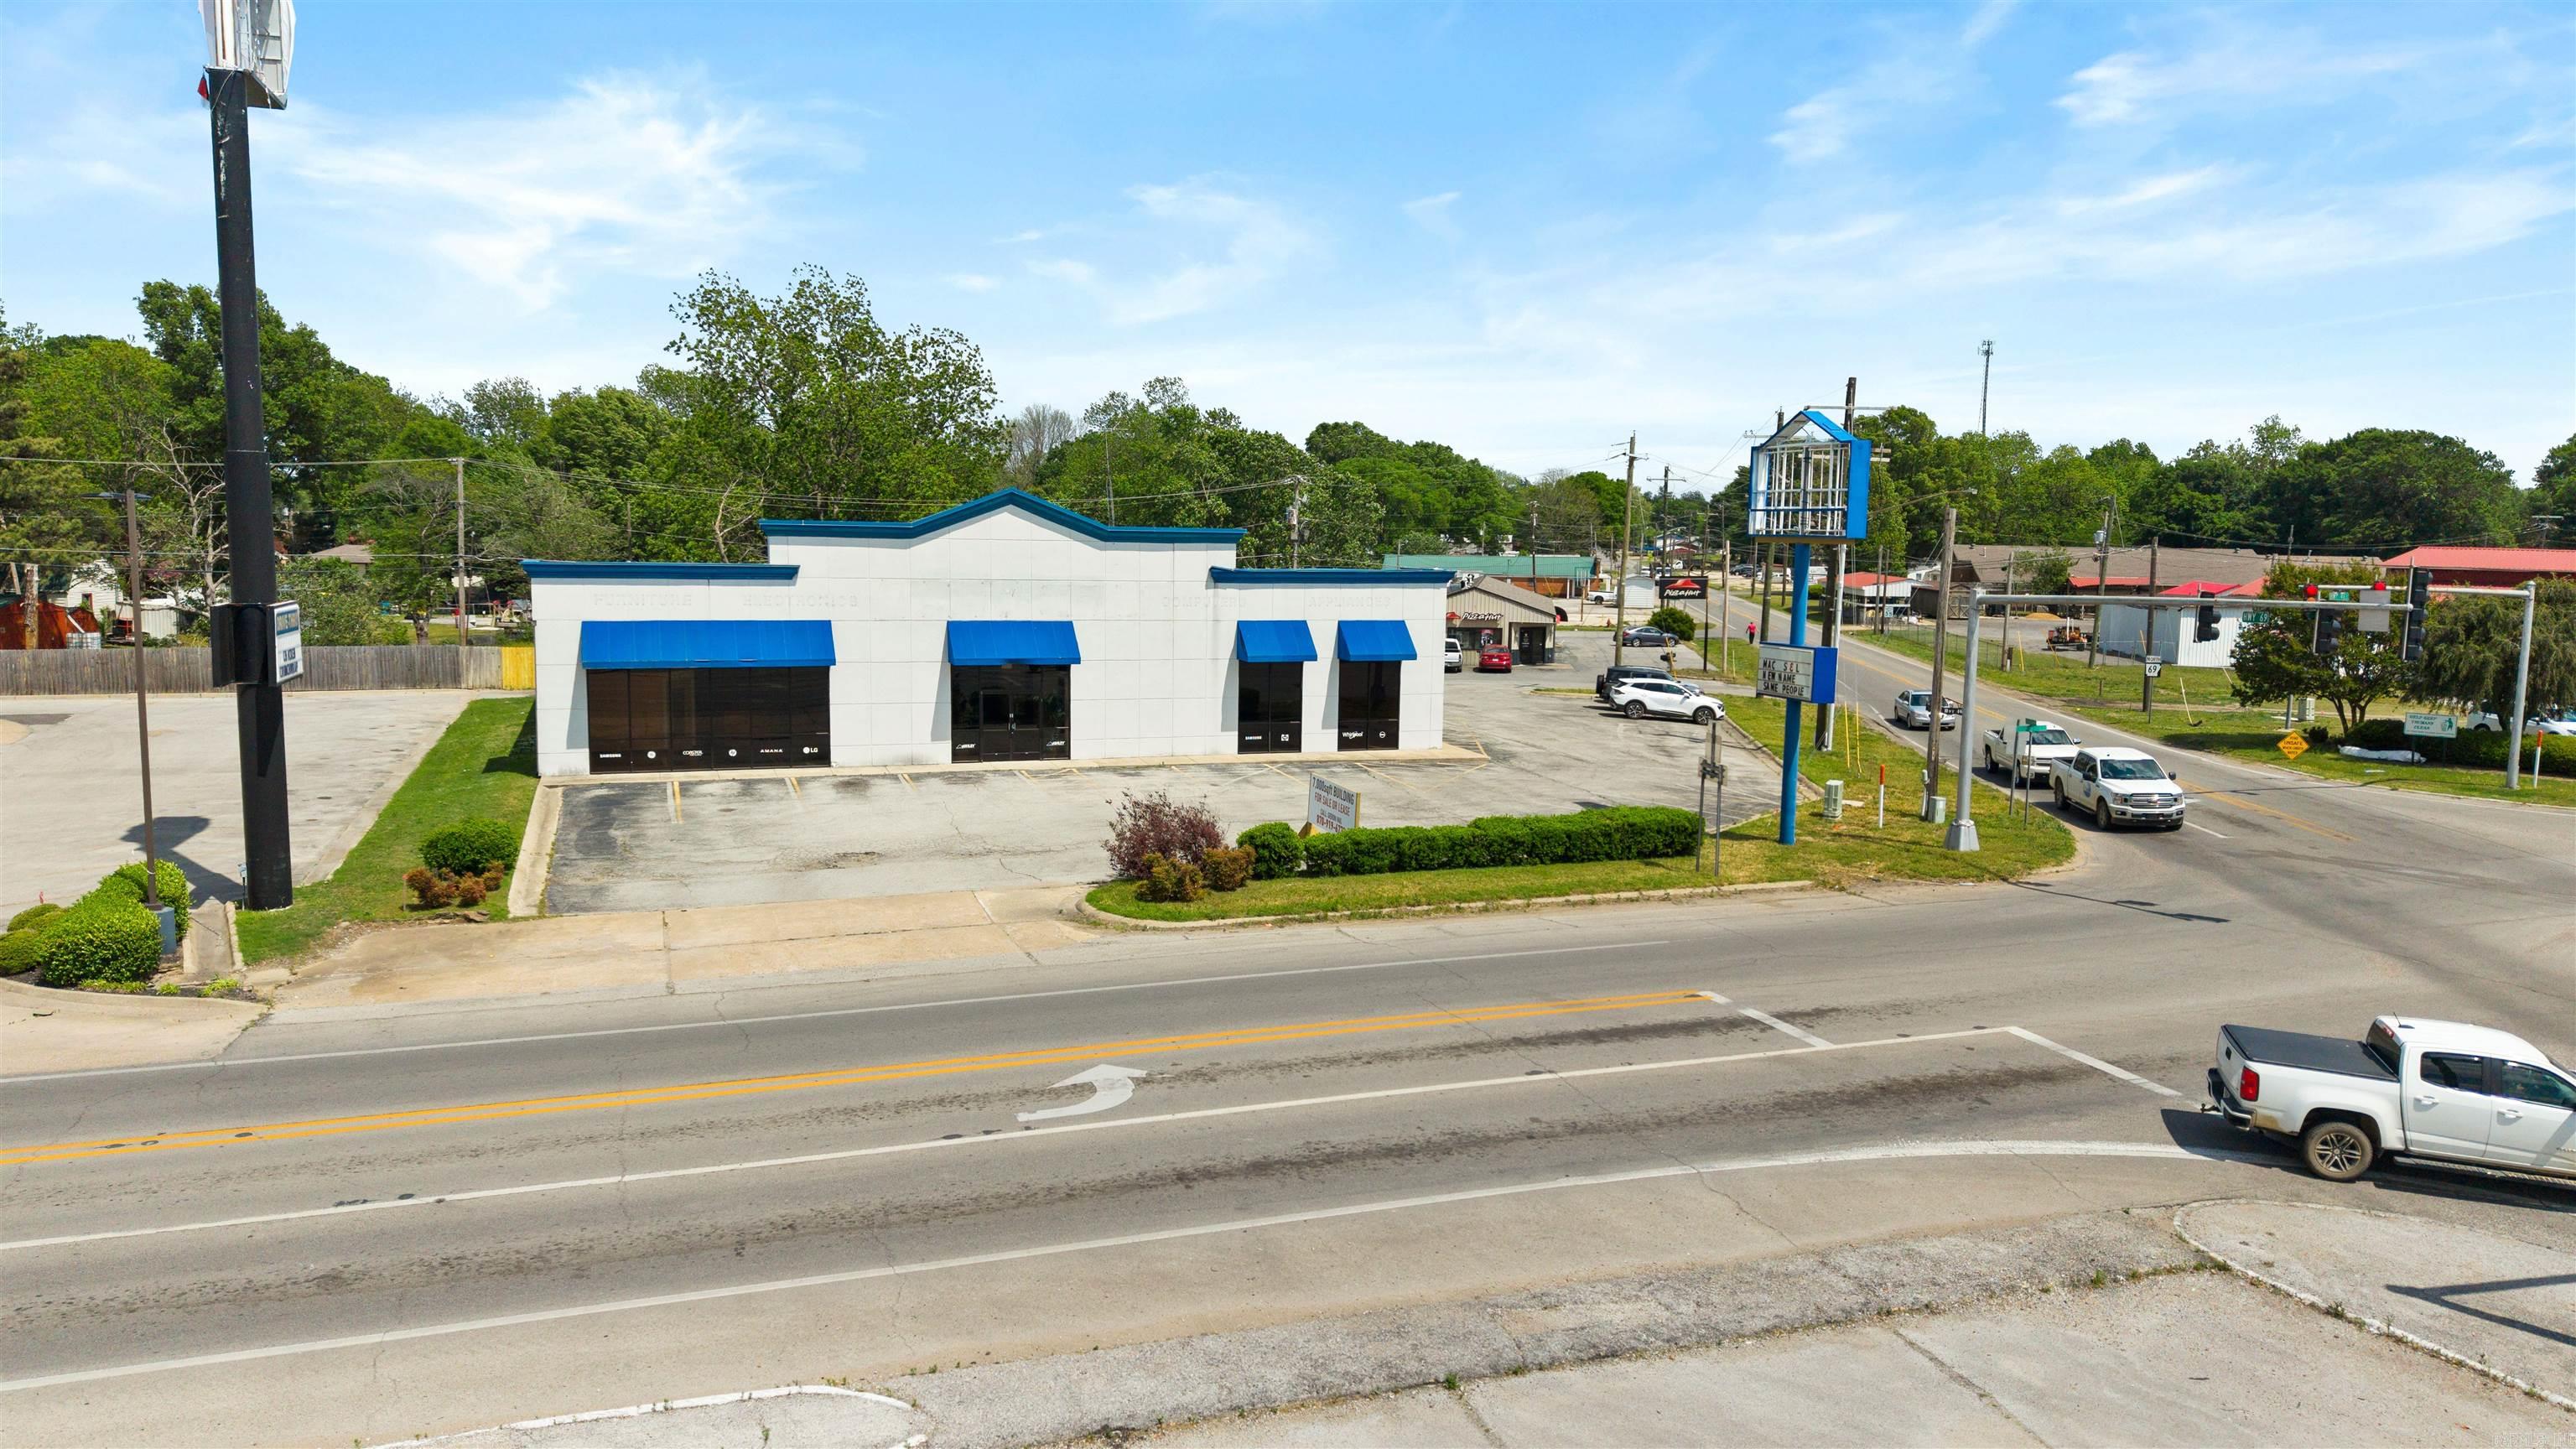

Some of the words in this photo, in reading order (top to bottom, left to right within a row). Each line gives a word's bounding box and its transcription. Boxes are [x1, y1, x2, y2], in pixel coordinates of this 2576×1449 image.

[1462, 612, 1484, 621] Pizza
[2243, 613, 2256, 621] HWY
[2259, 614, 2268, 622] 69
[1763, 659, 1776, 670] MAC
[1763, 671, 1775, 681] NEW
[1779, 673, 1795, 683] NAME
[1763, 682, 1778, 693] SAME
[1782, 684, 1805, 696] PEOPLE
[1333, 786, 1354, 805] BUILDING
[1322, 795, 1332, 808] SALE
[1338, 802, 1351, 817] LEASE
